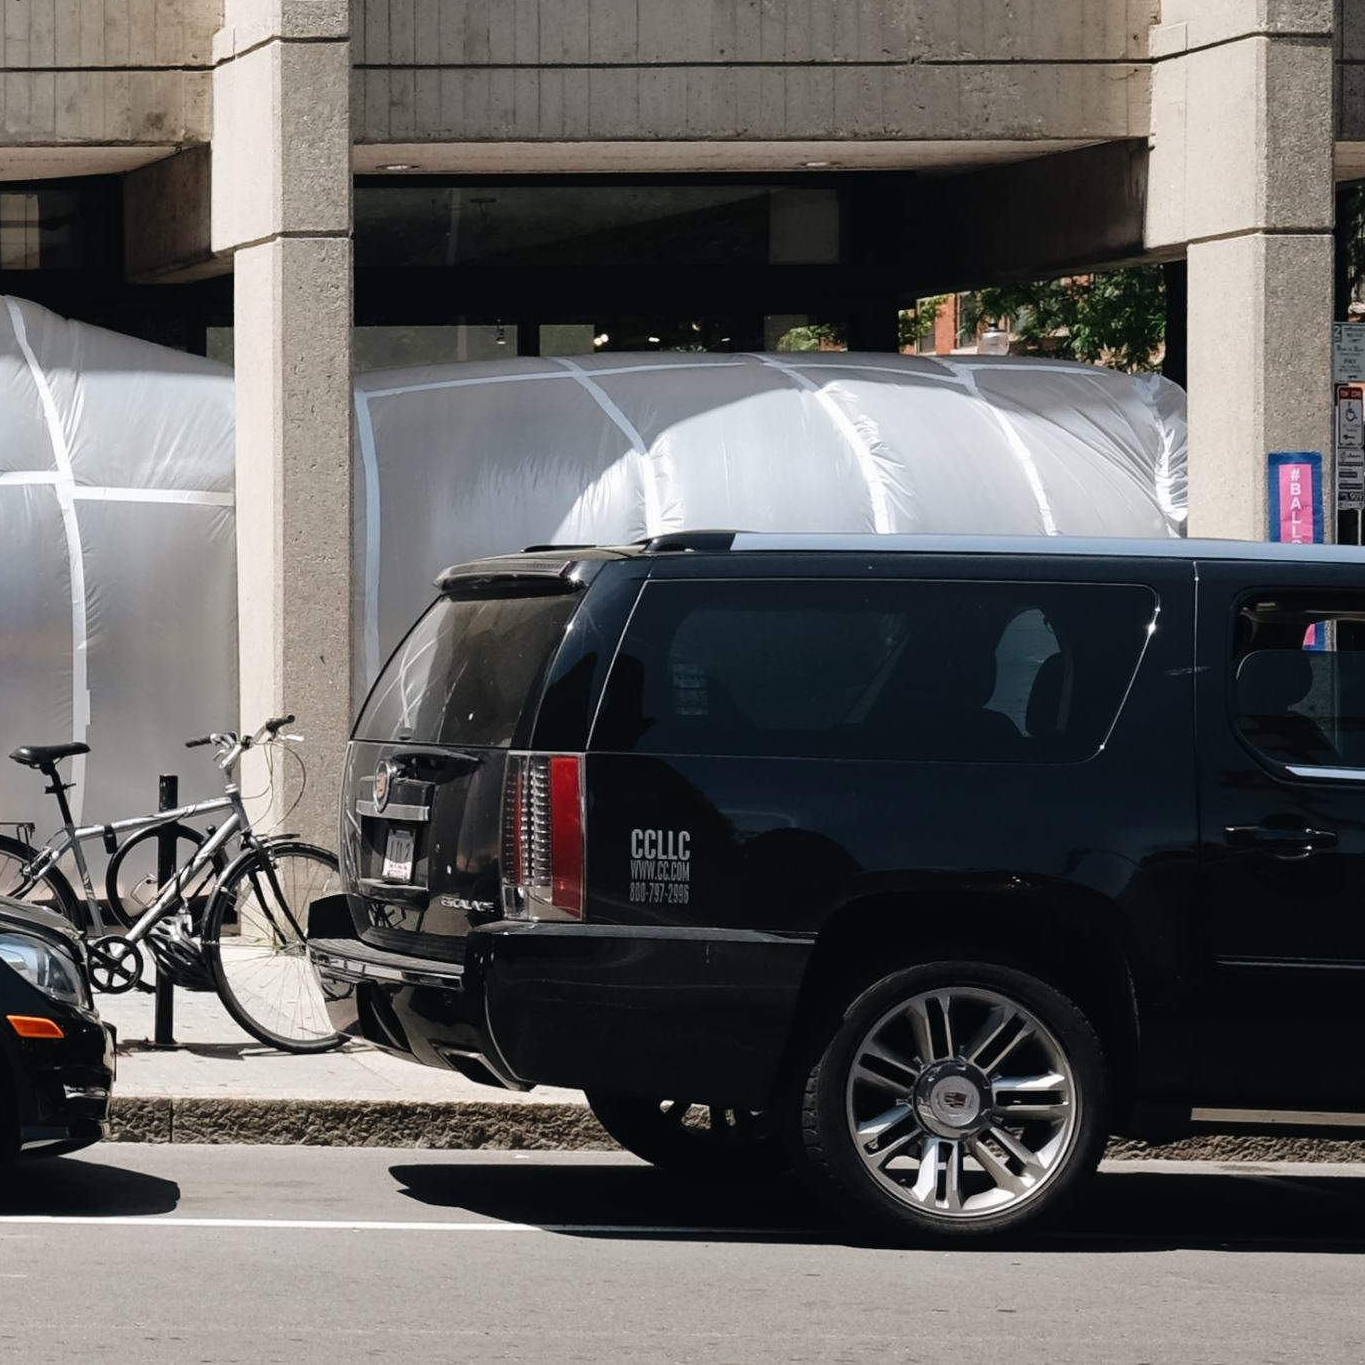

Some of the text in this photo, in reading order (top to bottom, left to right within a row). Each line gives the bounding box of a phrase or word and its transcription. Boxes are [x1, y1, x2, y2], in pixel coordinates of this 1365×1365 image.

[631, 828, 691, 861] CCLLC
[630, 859, 690, 882] WWW.CC.COM
[629, 881, 690, 904] 800-797-2996
